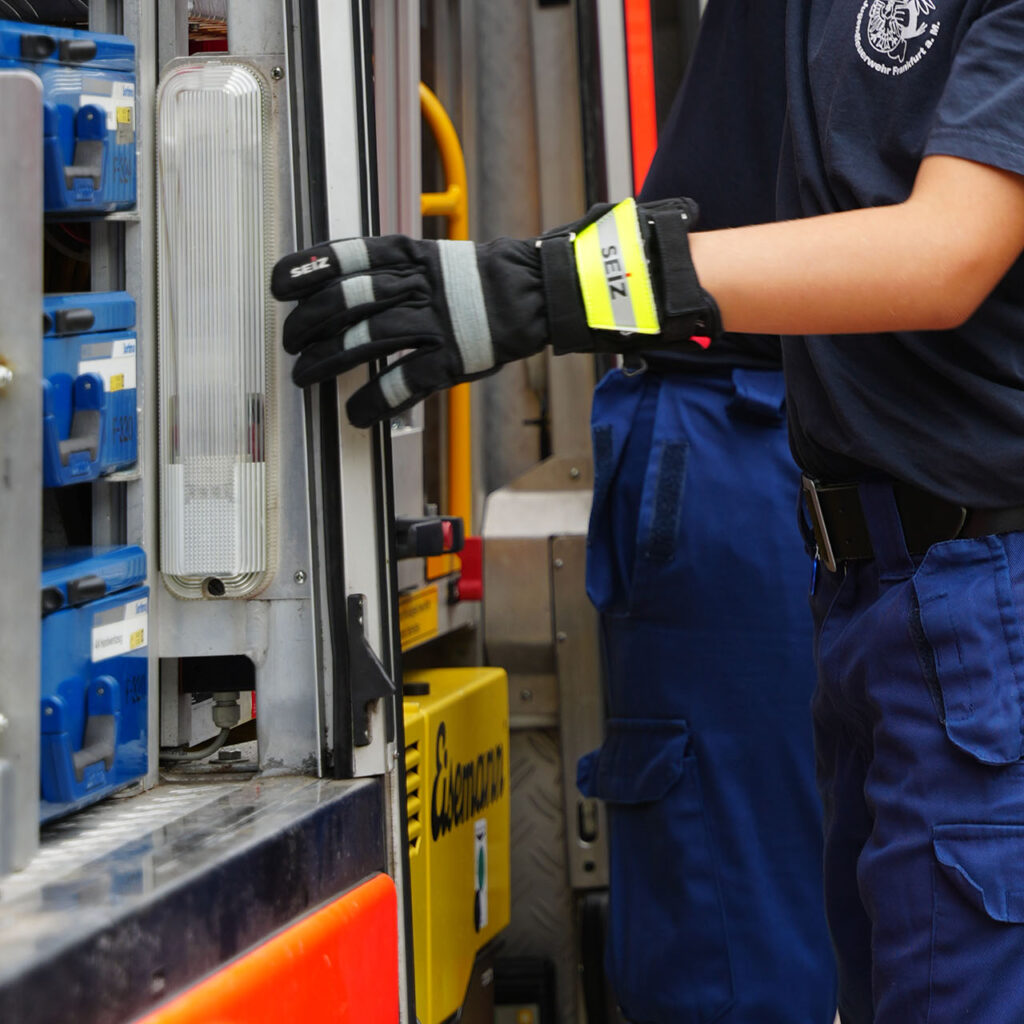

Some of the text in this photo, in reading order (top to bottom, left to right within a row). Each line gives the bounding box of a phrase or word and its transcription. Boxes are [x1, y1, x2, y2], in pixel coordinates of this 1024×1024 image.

[929, 21, 941, 36] M.
[924, 37, 935, 49] a.
[892, 47, 927, 76] Frankfurt
[290, 255, 331, 278] SEIZ
[602, 245, 632, 300] SEIZ
